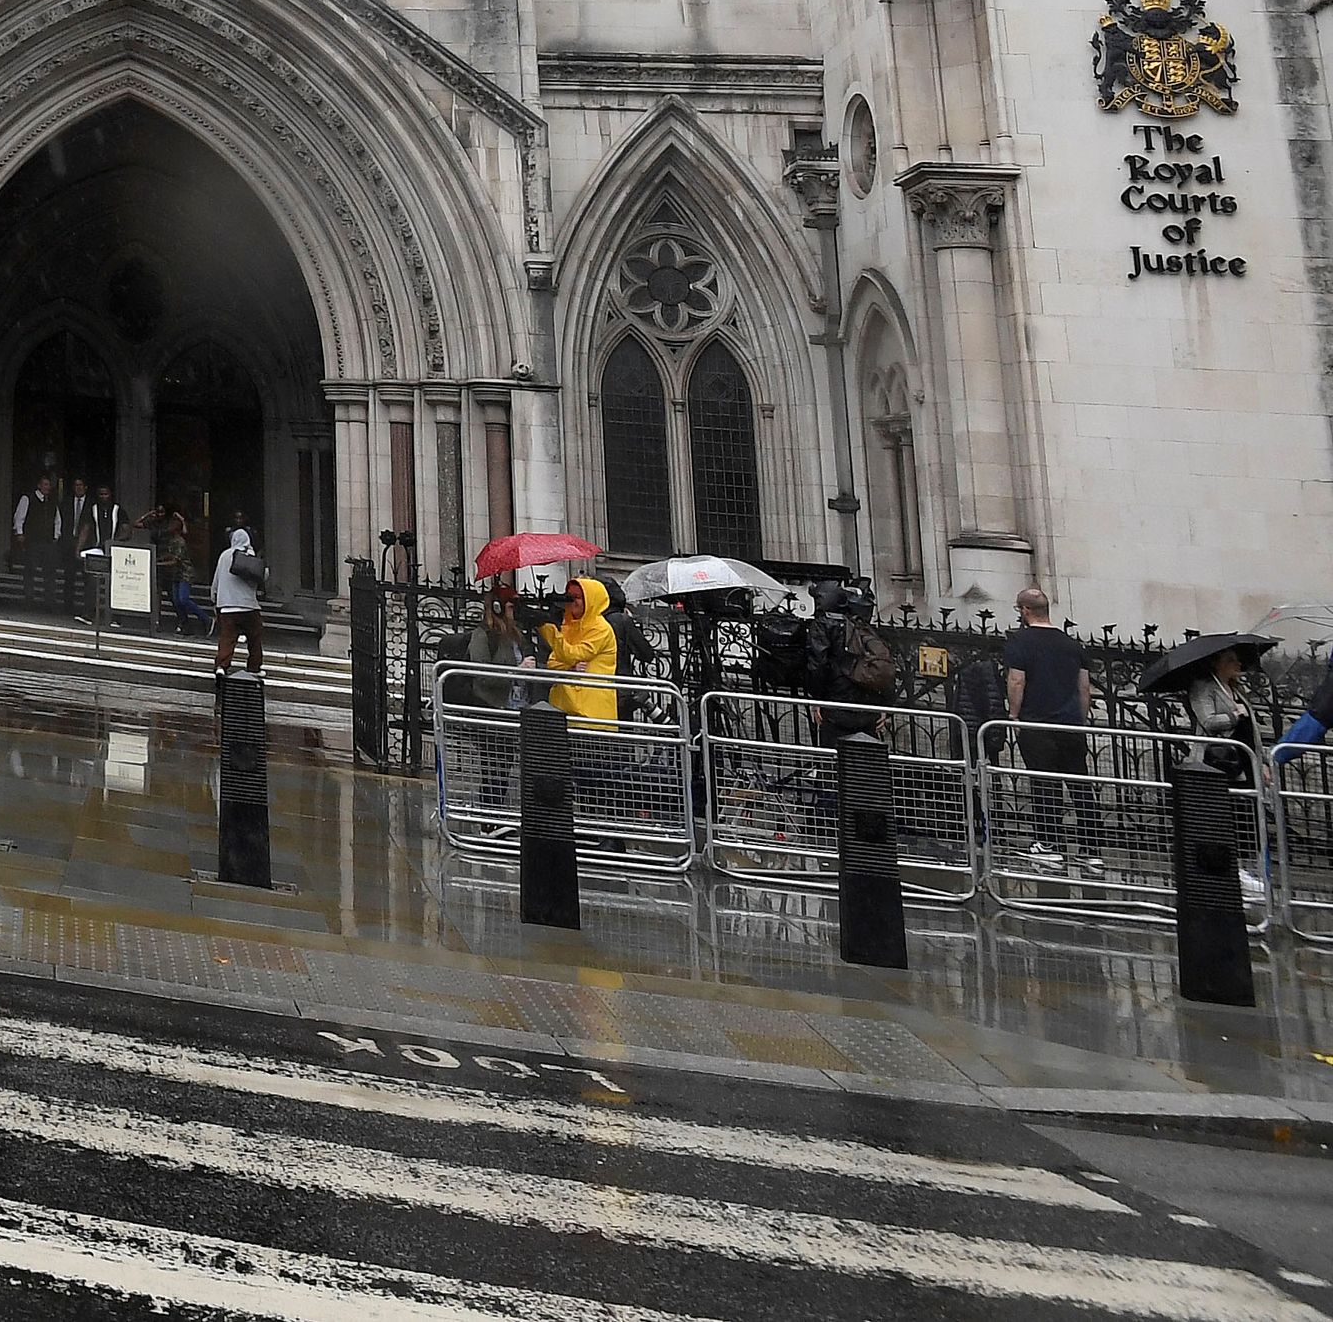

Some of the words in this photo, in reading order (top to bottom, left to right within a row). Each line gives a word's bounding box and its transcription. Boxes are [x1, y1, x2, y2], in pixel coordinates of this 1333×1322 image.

[1133, 125, 1204, 152] The
[1124, 155, 1225, 189] Royal
[1121, 185, 1238, 213] Courts
[1162, 218, 1202, 244] of
[1128, 246, 1247, 279] Justice
[316, 1031, 626, 1093] LOOK
